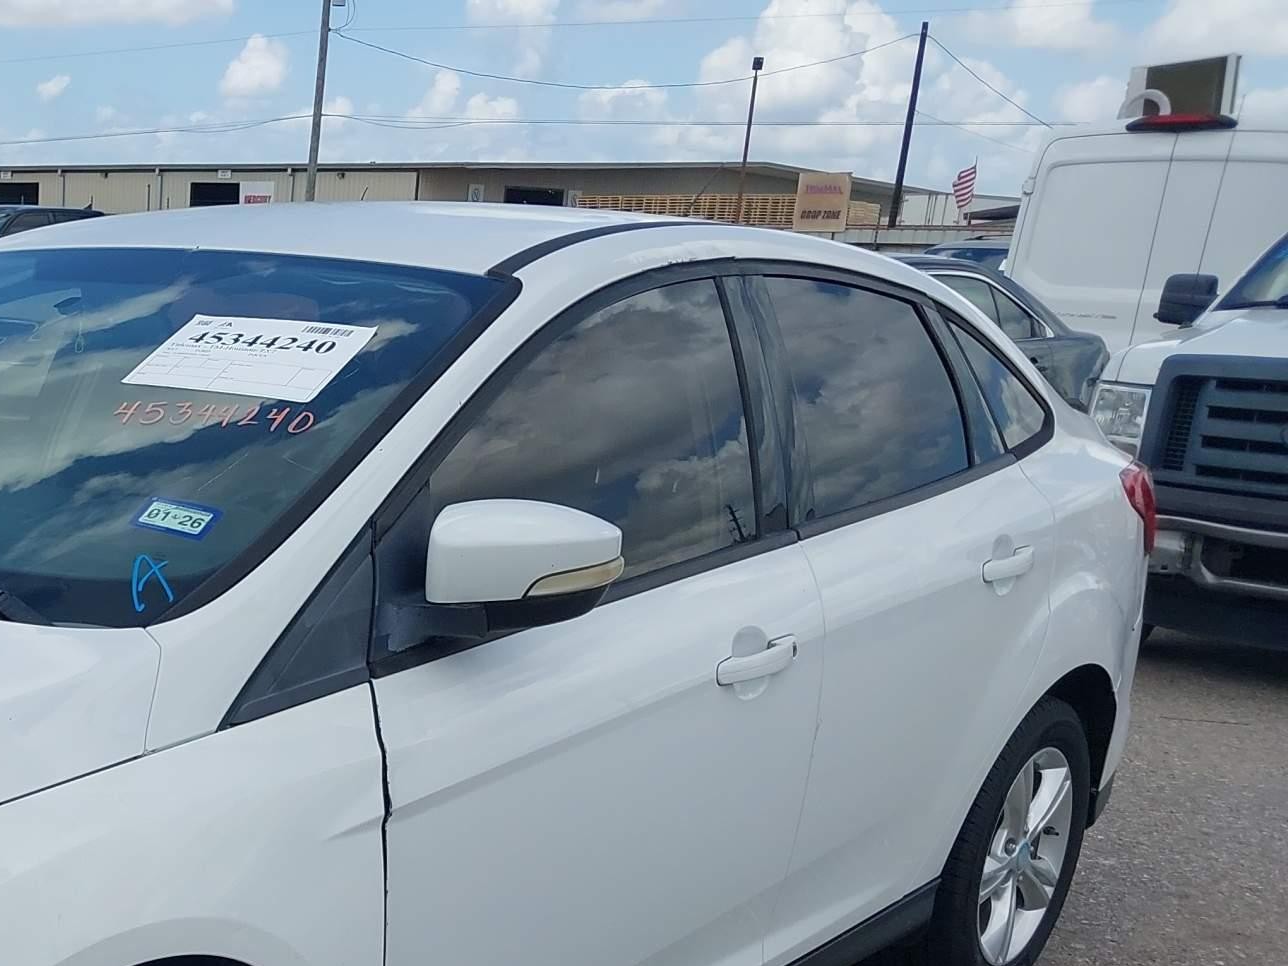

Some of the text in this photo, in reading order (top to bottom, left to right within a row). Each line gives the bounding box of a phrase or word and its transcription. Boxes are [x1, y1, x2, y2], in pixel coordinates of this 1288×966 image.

[188, 331, 337, 355] 45344240
[113, 400, 314, 434] 45344240
[178, 514, 205, 529] 26
